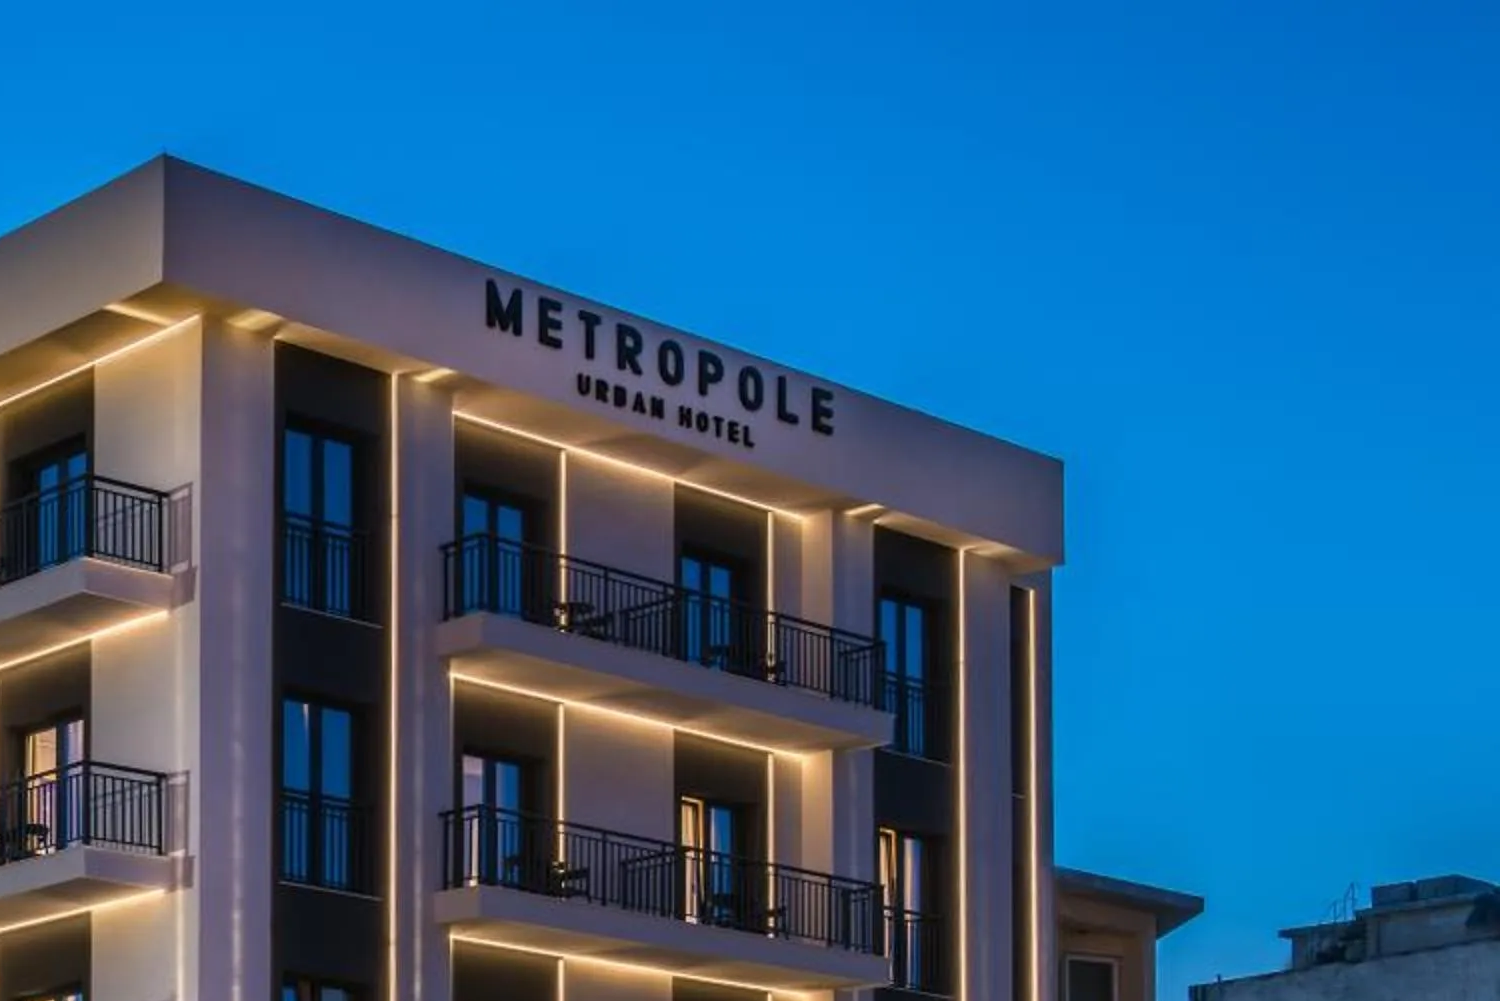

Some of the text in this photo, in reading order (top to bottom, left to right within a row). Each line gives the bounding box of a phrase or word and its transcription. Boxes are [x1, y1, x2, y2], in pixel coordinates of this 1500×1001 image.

[485, 279, 834, 436] METROPOLE
[577, 373, 756, 448] URBAN HOTEL
